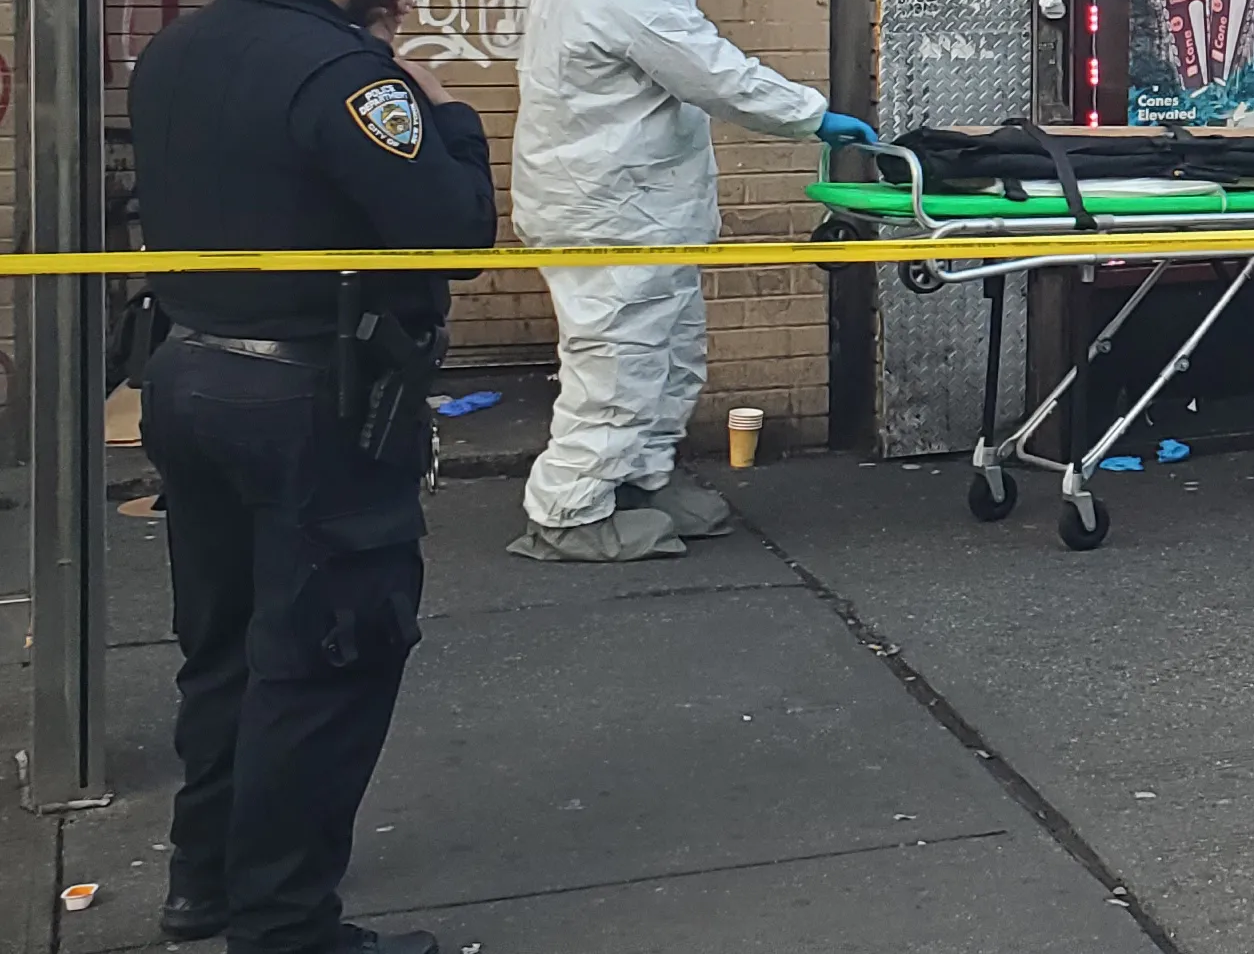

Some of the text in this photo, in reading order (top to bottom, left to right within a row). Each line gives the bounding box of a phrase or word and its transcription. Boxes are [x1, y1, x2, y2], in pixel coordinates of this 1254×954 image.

[1215, 15, 1228, 49] Cone
[1184, 29, 1196, 65] Cone
[364, 84, 396, 102] POLICE
[1138, 95, 1179, 107] Cones
[1138, 107, 1196, 121] Elevated
[367, 123, 387, 140] CITY
